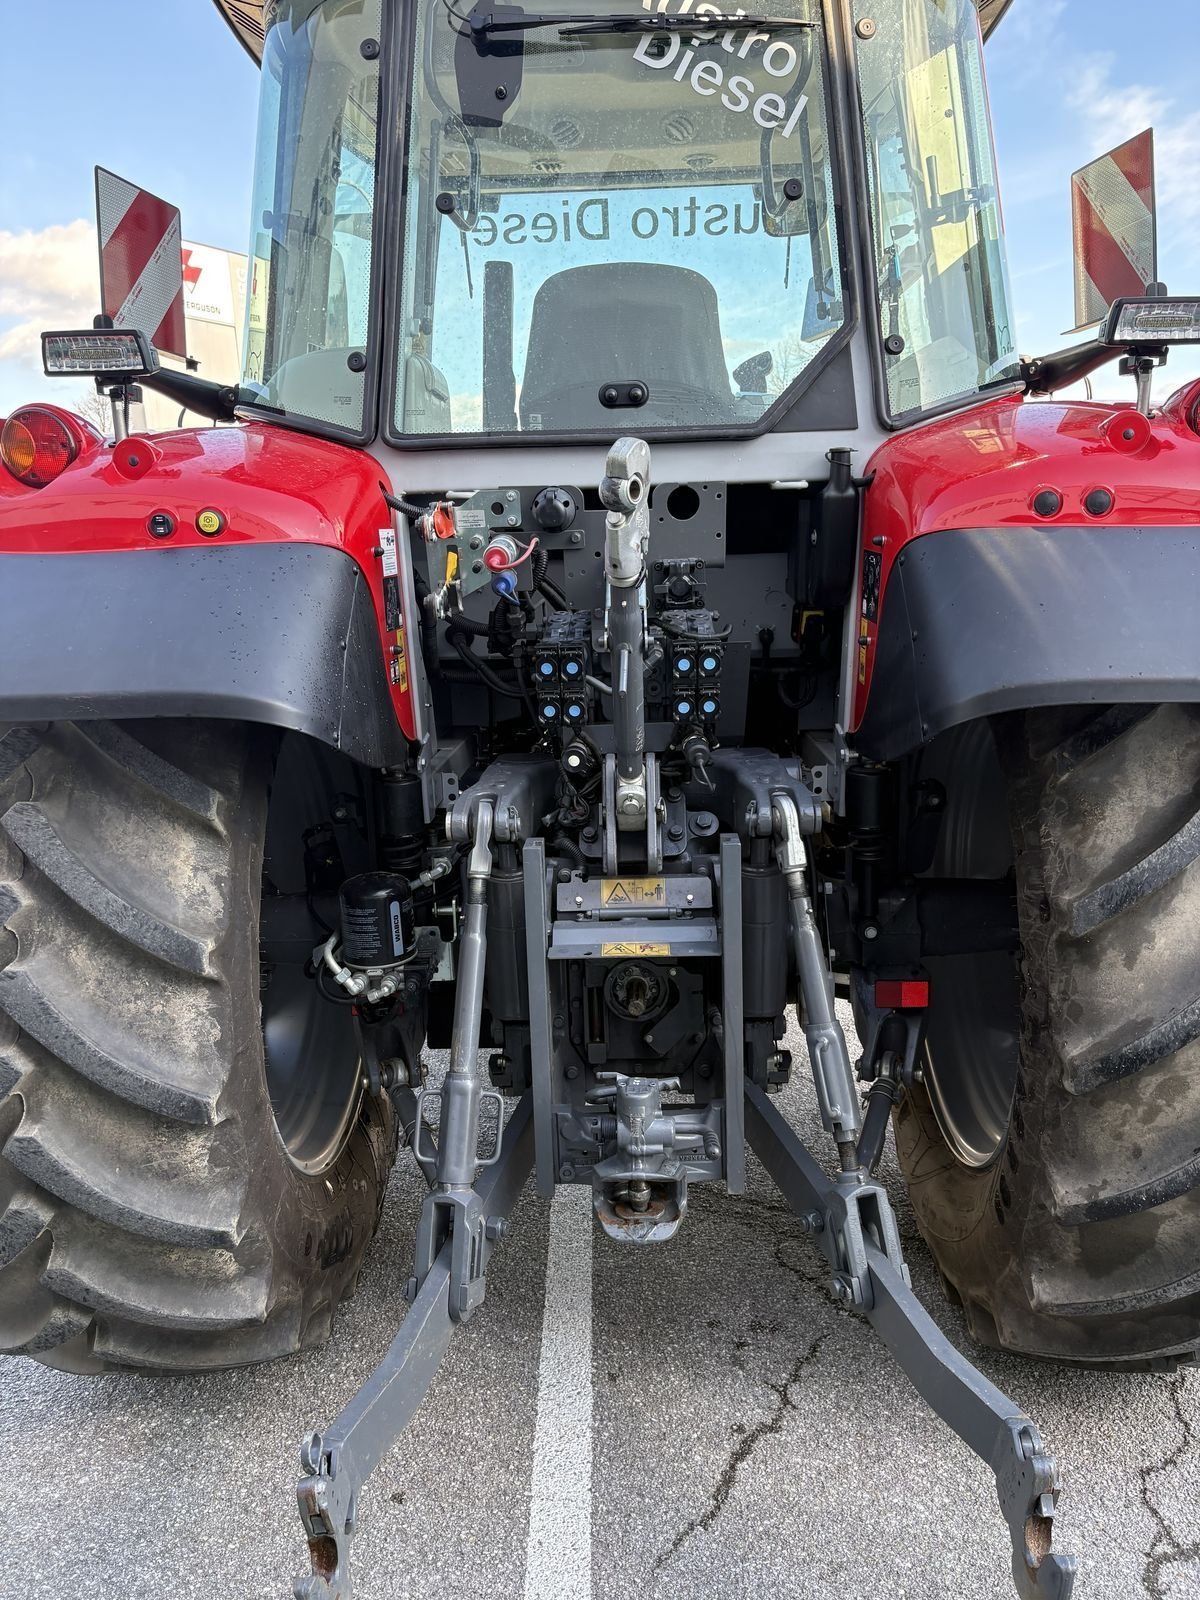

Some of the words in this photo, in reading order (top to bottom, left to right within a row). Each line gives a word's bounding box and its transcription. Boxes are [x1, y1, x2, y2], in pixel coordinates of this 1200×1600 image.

[642, 0, 797, 77] ustro
[633, 28, 809, 139] Diesel
[185, 301, 221, 315] ERGUSON
[393, 914, 401, 943] WABCO
